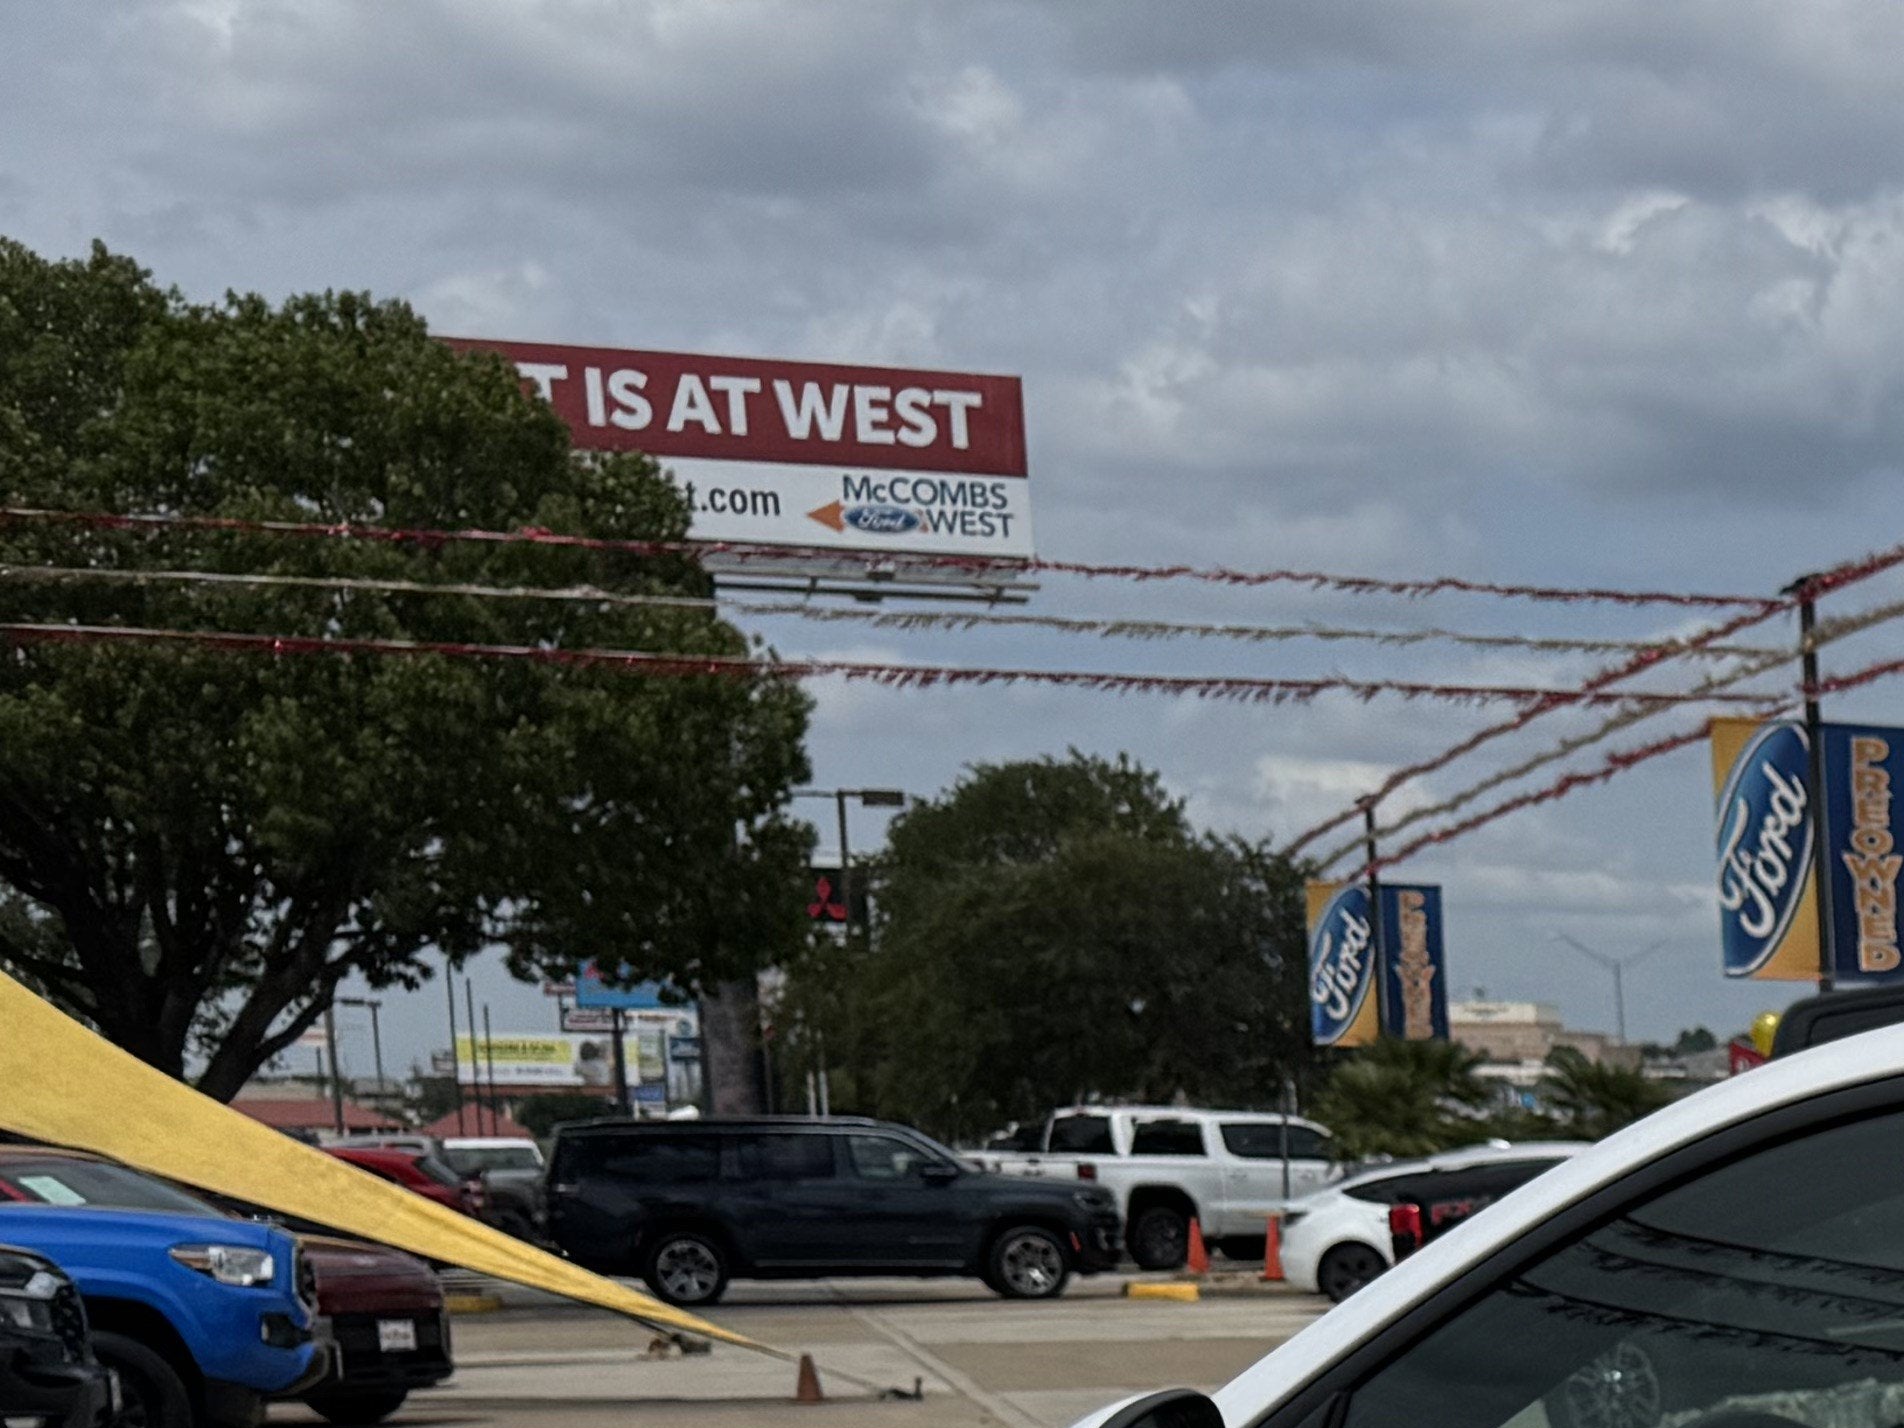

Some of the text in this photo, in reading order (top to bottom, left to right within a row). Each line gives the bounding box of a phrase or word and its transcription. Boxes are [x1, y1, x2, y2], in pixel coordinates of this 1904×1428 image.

[585, 366, 653, 432] IS
[666, 373, 761, 437] AT
[772, 379, 982, 450] WEST
[843, 475, 1008, 510] McCOMBS
[857, 506, 1015, 538] Ford WEST
[1719, 761, 1808, 939] Ford
[1842, 734, 1904, 972] PREOWNED
[1310, 906, 1371, 1020] Ford
